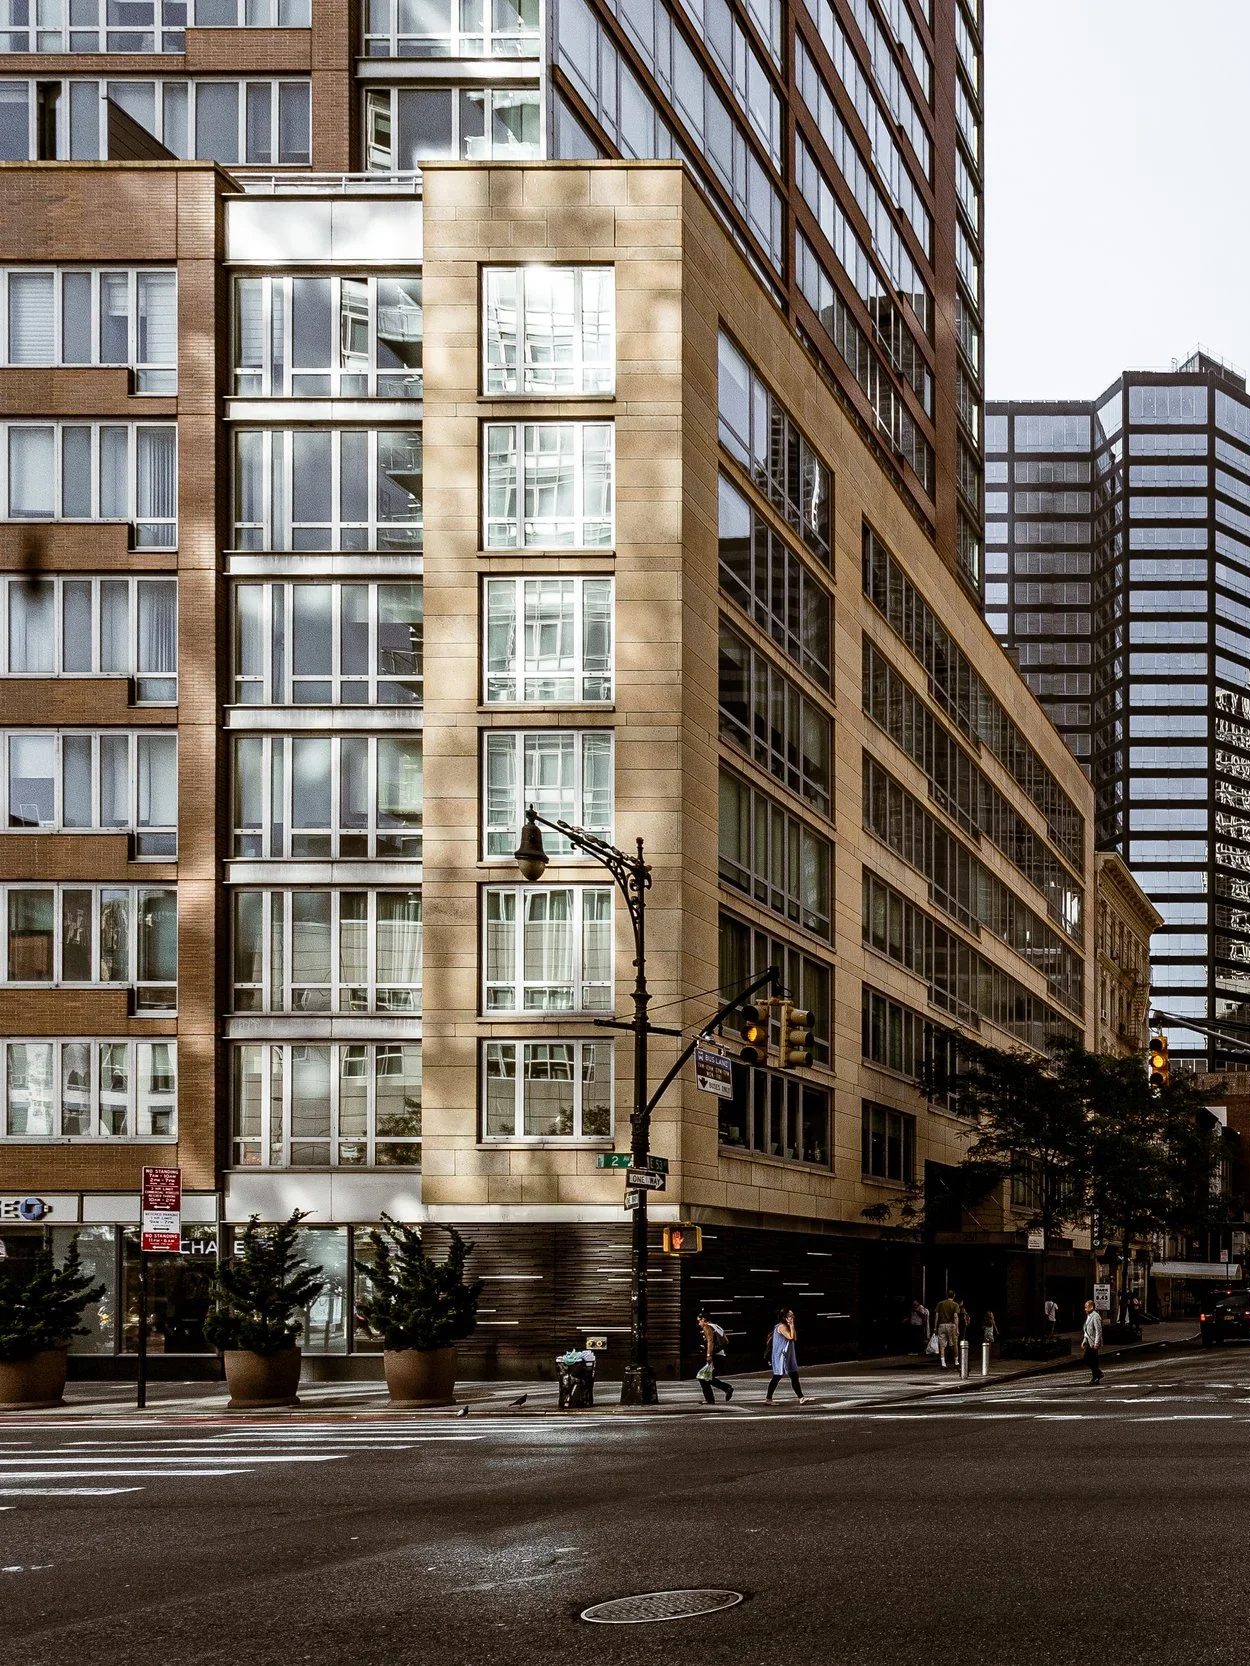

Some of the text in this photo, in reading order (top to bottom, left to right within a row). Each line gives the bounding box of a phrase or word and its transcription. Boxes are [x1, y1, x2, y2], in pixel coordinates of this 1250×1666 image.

[611, 1155, 619, 1167] 2
[632, 1175, 645, 1184] ONE
[180, 1240, 246, 1254] CHAE
